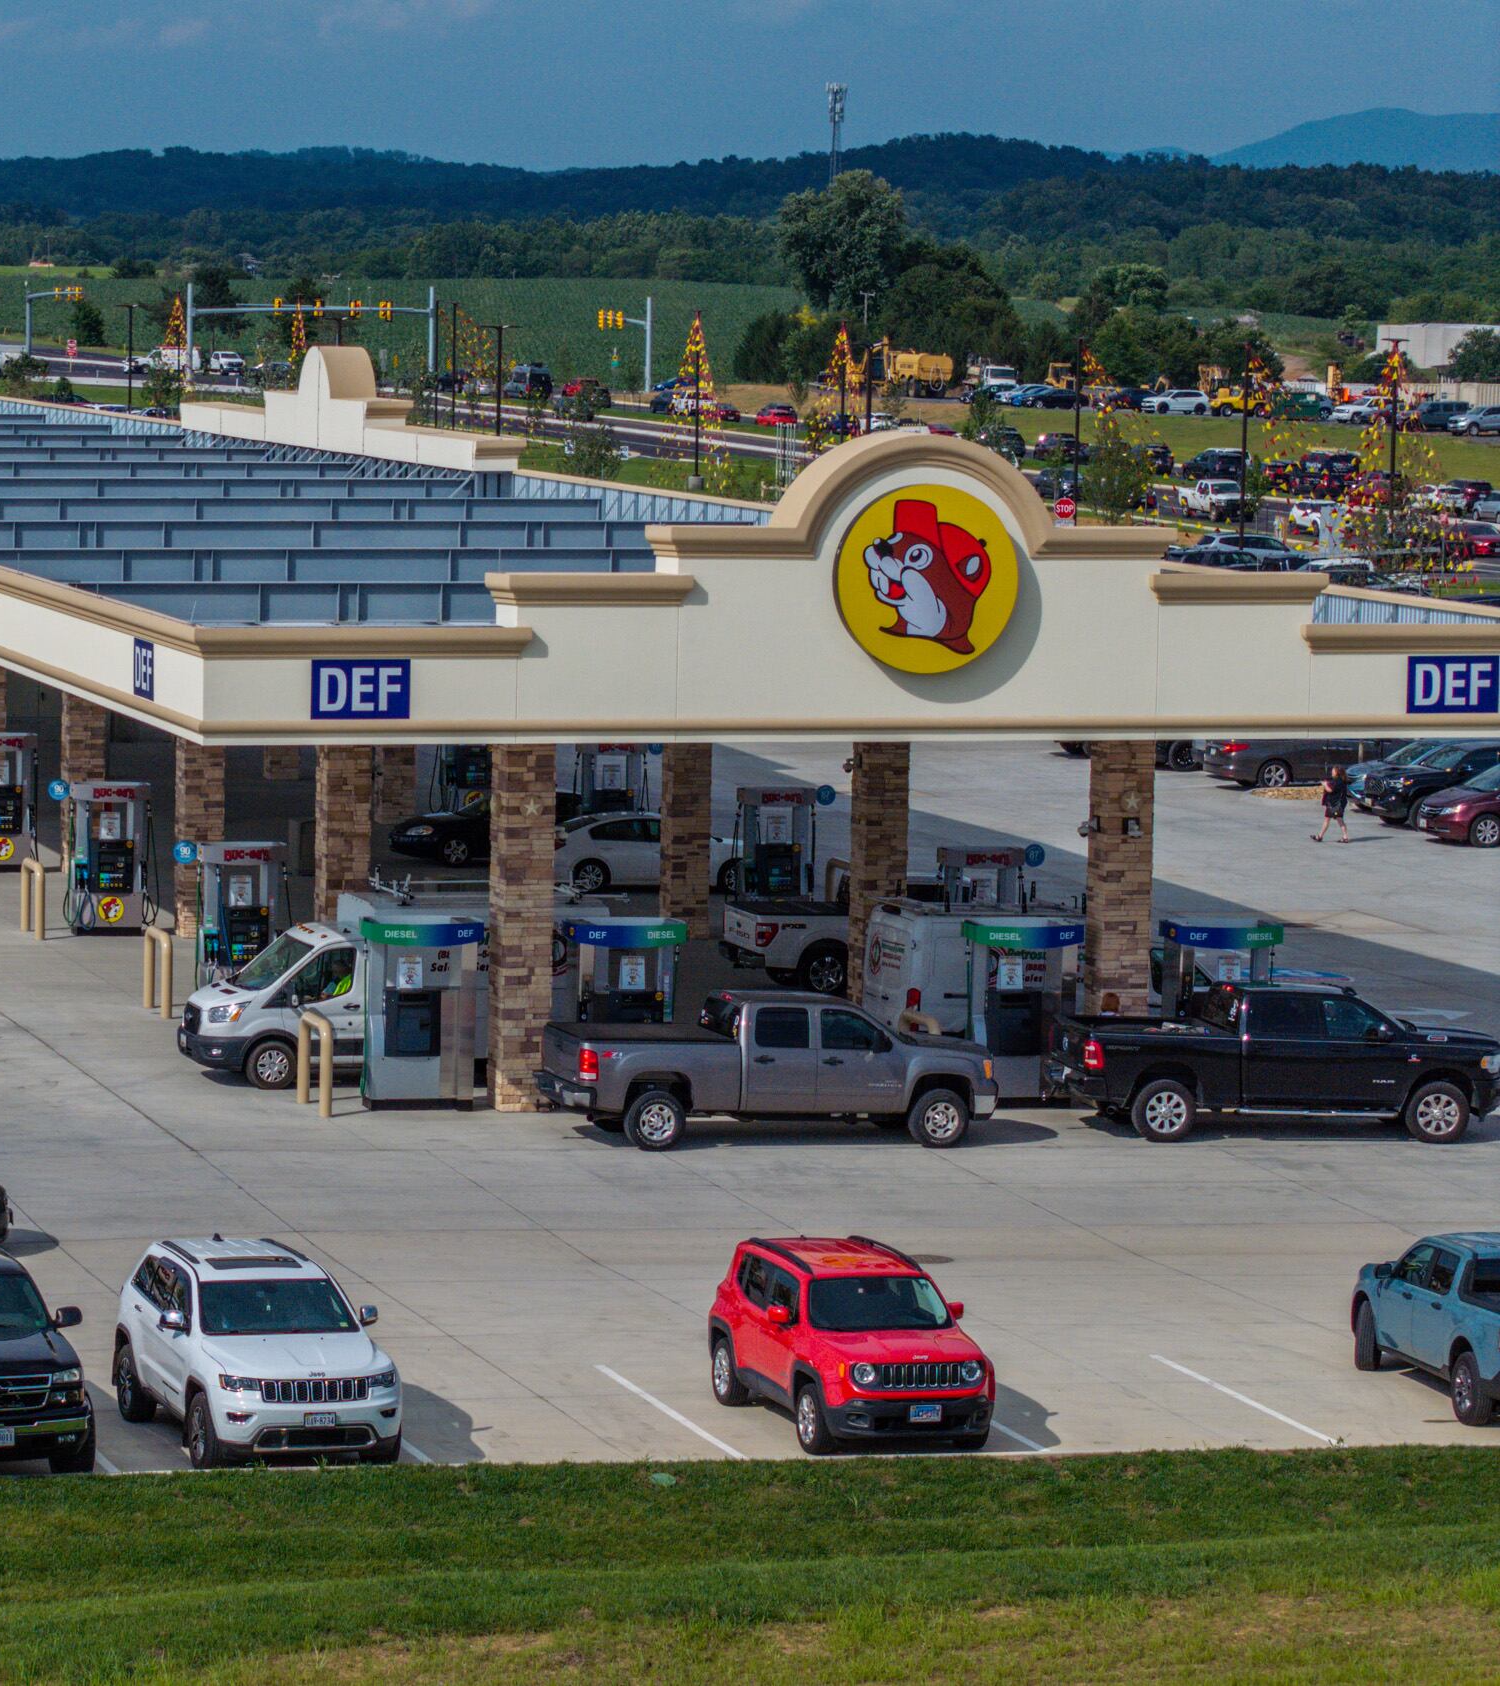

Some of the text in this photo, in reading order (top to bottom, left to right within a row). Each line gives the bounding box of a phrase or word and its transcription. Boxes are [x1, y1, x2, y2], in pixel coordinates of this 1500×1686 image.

[1056, 504, 1074, 513] STOP
[134, 645, 153, 692] DEF
[1413, 661, 1492, 706] DEF
[318, 666, 403, 712] DEF
[54, 784, 64, 793] 90
[179, 846, 191, 856] 90
[1029, 850, 1039, 861] 87
[384, 929, 474, 938] DIESEL DEF
[588, 930, 677, 939] DEF DIESEL
[989, 931, 1075, 941] DIESEL DEF
[1189, 932, 1274, 941] DEF DIESEL
[1022, 974, 1043, 983] ales
